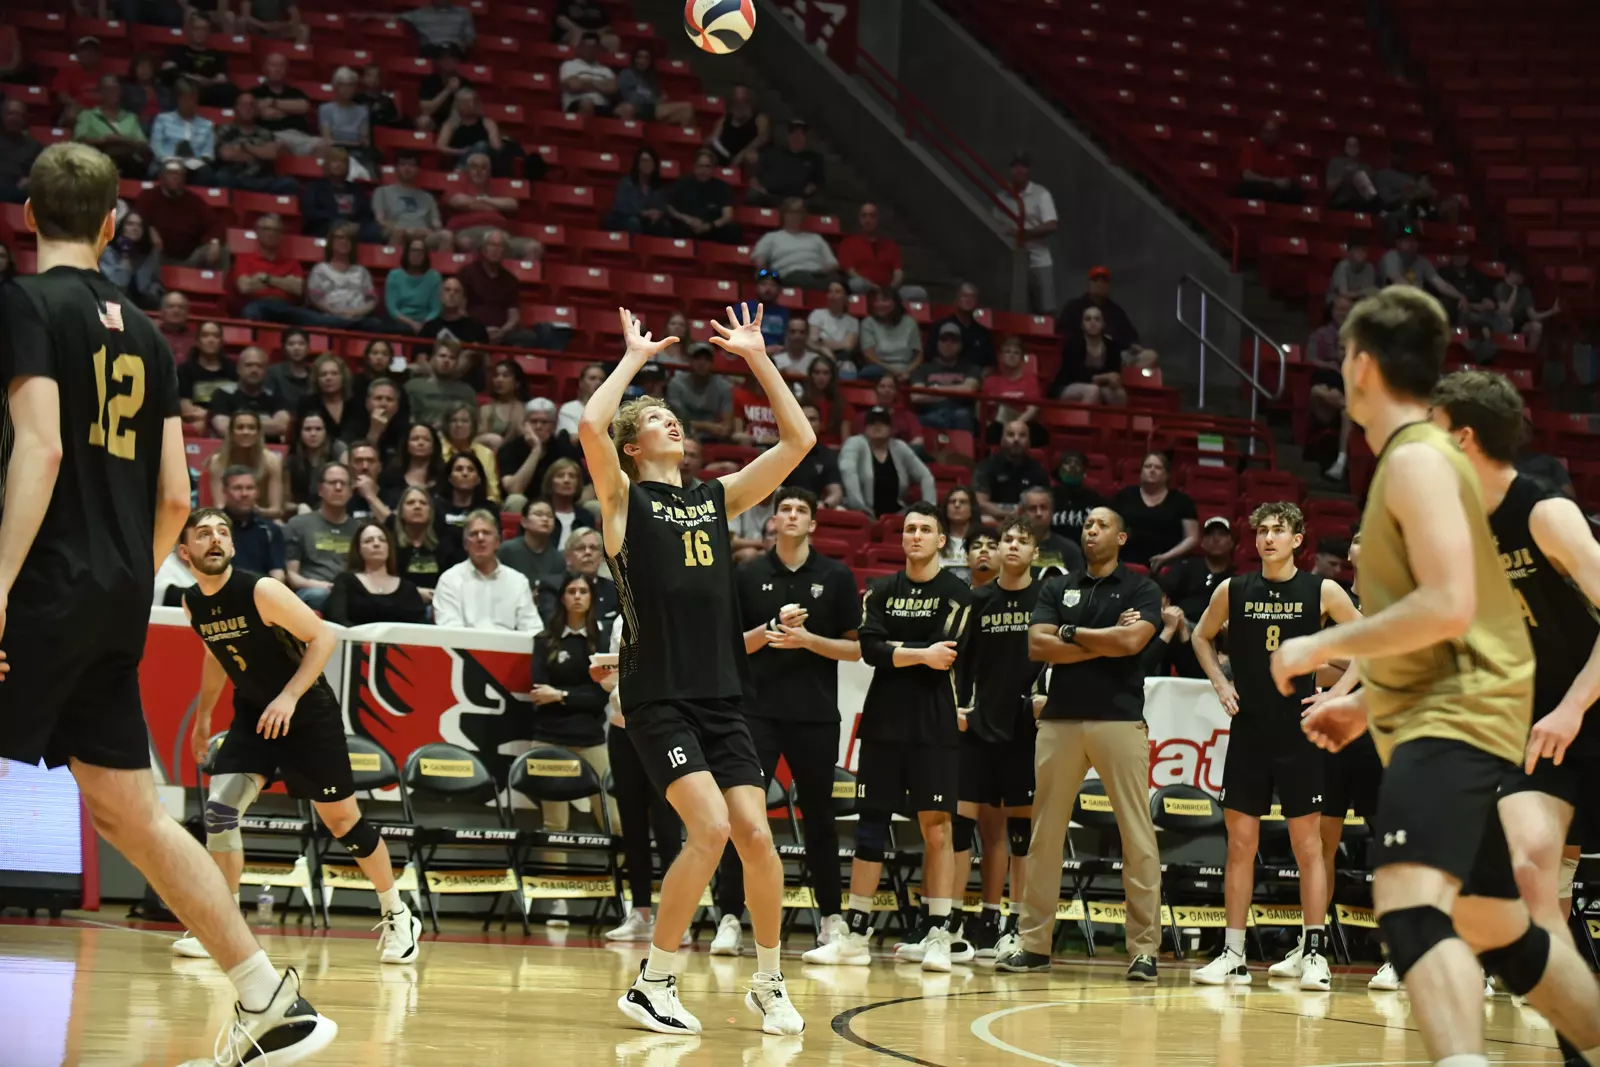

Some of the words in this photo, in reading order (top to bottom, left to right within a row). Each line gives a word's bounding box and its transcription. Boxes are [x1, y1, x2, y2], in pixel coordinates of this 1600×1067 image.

[88, 343, 146, 460] 12
[651, 500, 716, 519] PURDUE
[682, 529, 714, 567] 16
[1244, 602, 1303, 613] PURDUE
[981, 611, 1032, 627] PURDU
[1265, 625, 1280, 651] 8
[667, 746, 687, 768] 16
[1172, 801, 1210, 813] GAINBRIDGE
[269, 820, 303, 831] STATE
[380, 826, 414, 836] STATE
[456, 829, 481, 838] BALL
[484, 830, 517, 840] STATE
[548, 834, 574, 843] BALL
[577, 835, 611, 845] STATE
[779, 845, 806, 854] STAT
[1199, 867, 1223, 875] BALL
[540, 880, 612, 892] GAINBRIDGE
